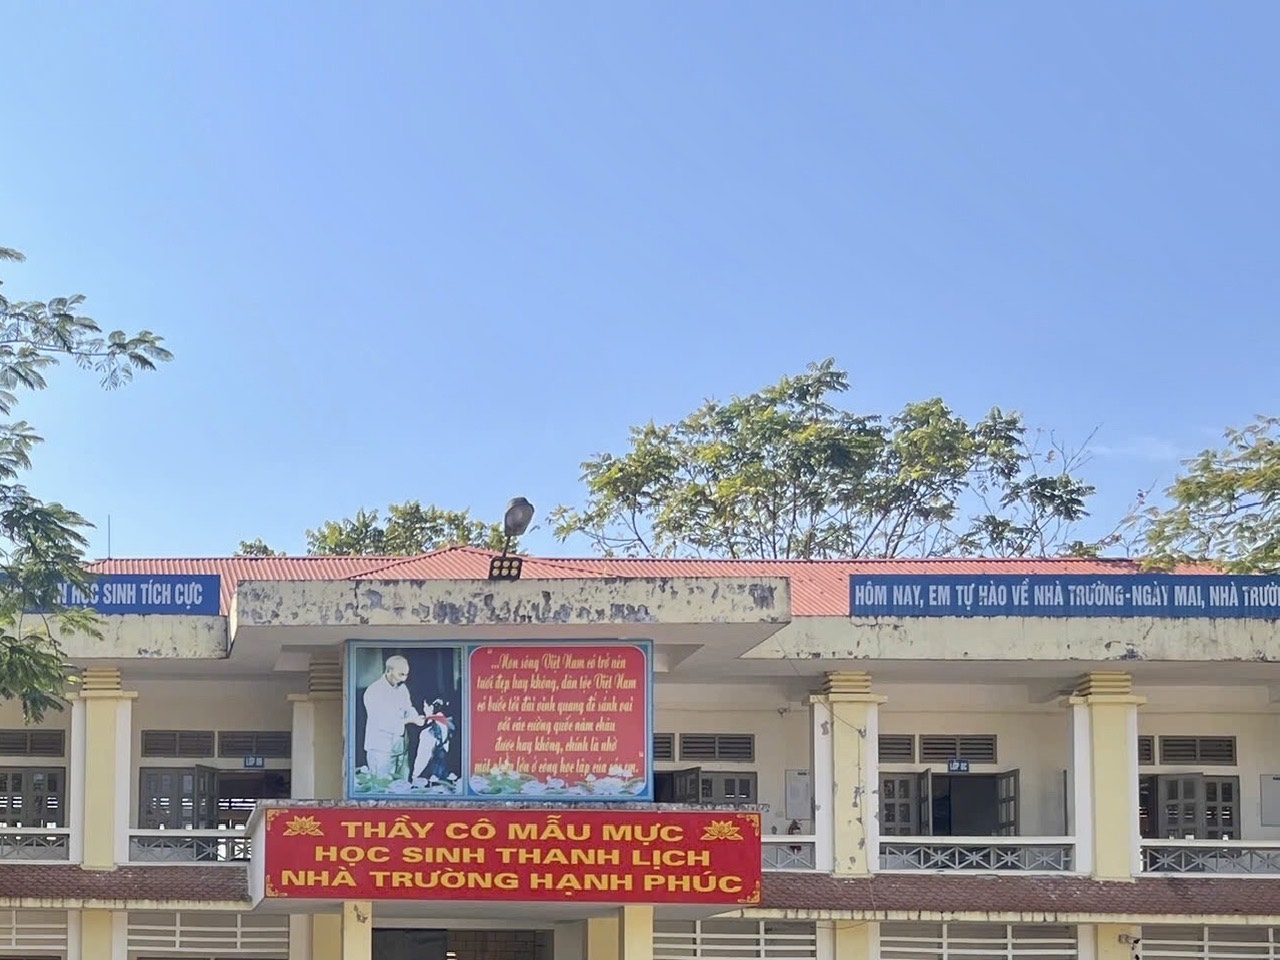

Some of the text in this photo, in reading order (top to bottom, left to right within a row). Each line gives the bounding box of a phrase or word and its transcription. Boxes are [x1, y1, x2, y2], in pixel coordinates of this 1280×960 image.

[103, 584, 136, 605] SINH
[140, 579, 171, 605] TÍCH
[174, 584, 202, 610] CỰC
[855, 580, 887, 606] HÔM
[892, 585, 923, 608] NAY,
[929, 585, 951, 606] EM
[956, 583, 975, 611] TỰ
[978, 580, 1007, 606] HÀO
[1011, 578, 1030, 606] VỀ
[1034, 580, 1063, 606] NHÀ
[1174, 585, 1205, 608] MAI,
[1210, 580, 1239, 606] NHÀ
[1243, 579, 1280, 606] TRƯỜ
[542, 653, 560, 673] Việt
[563, 653, 585, 669] Nam
[512, 674, 528, 693] hay
[593, 673, 612, 693] Việt
[614, 673, 636, 690] Nam
[557, 699, 584, 715] quang
[516, 736, 532, 754] hay
[565, 736, 588, 751] chính
[341, 815, 683, 845] THẦY CÔ MẪU MỰC
[315, 846, 710, 870] HỌC SINH THANH LỊCH
[281, 866, 742, 896] NHÀ TRƯỜNG HẠNH PHÚC
